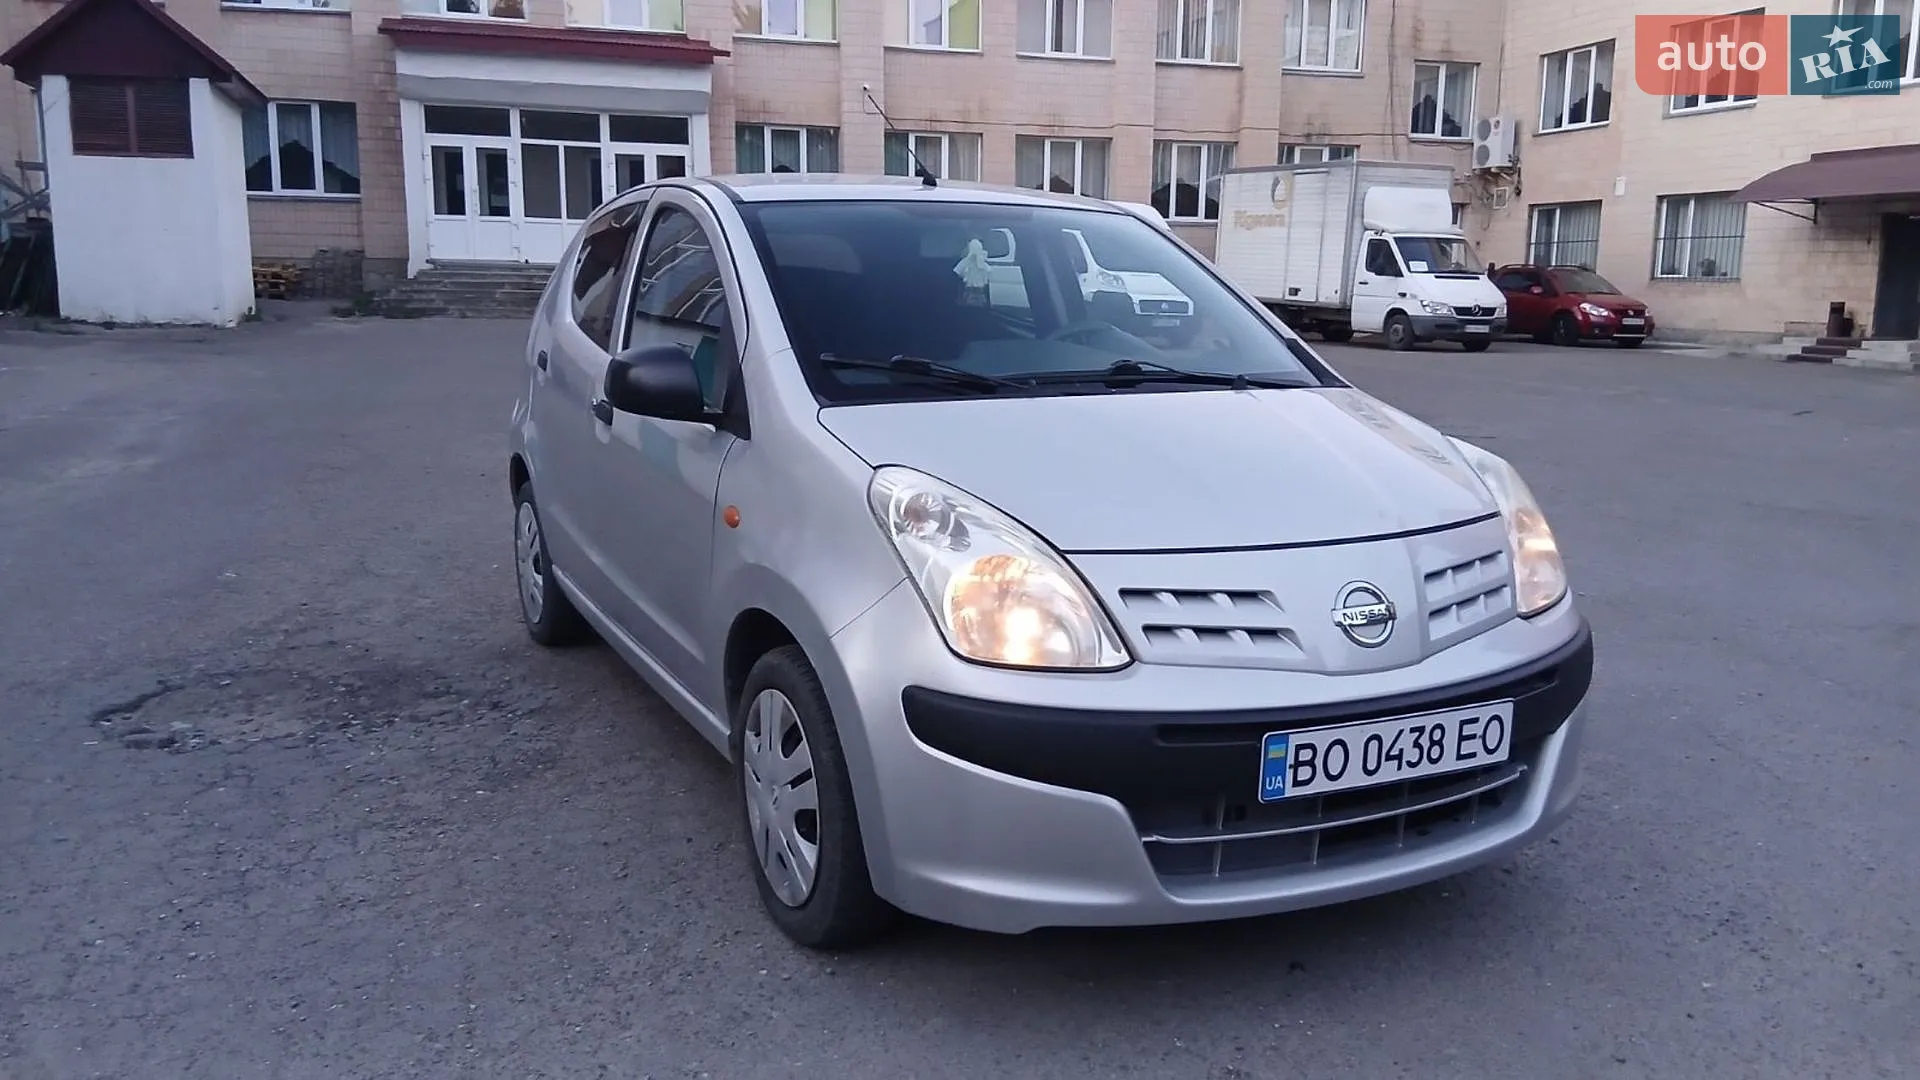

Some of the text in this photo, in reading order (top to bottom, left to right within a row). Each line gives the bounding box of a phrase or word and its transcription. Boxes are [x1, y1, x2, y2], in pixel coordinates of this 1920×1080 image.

[1291, 714, 1505, 788] BO 0438 EO
[1265, 776, 1284, 791] UA
